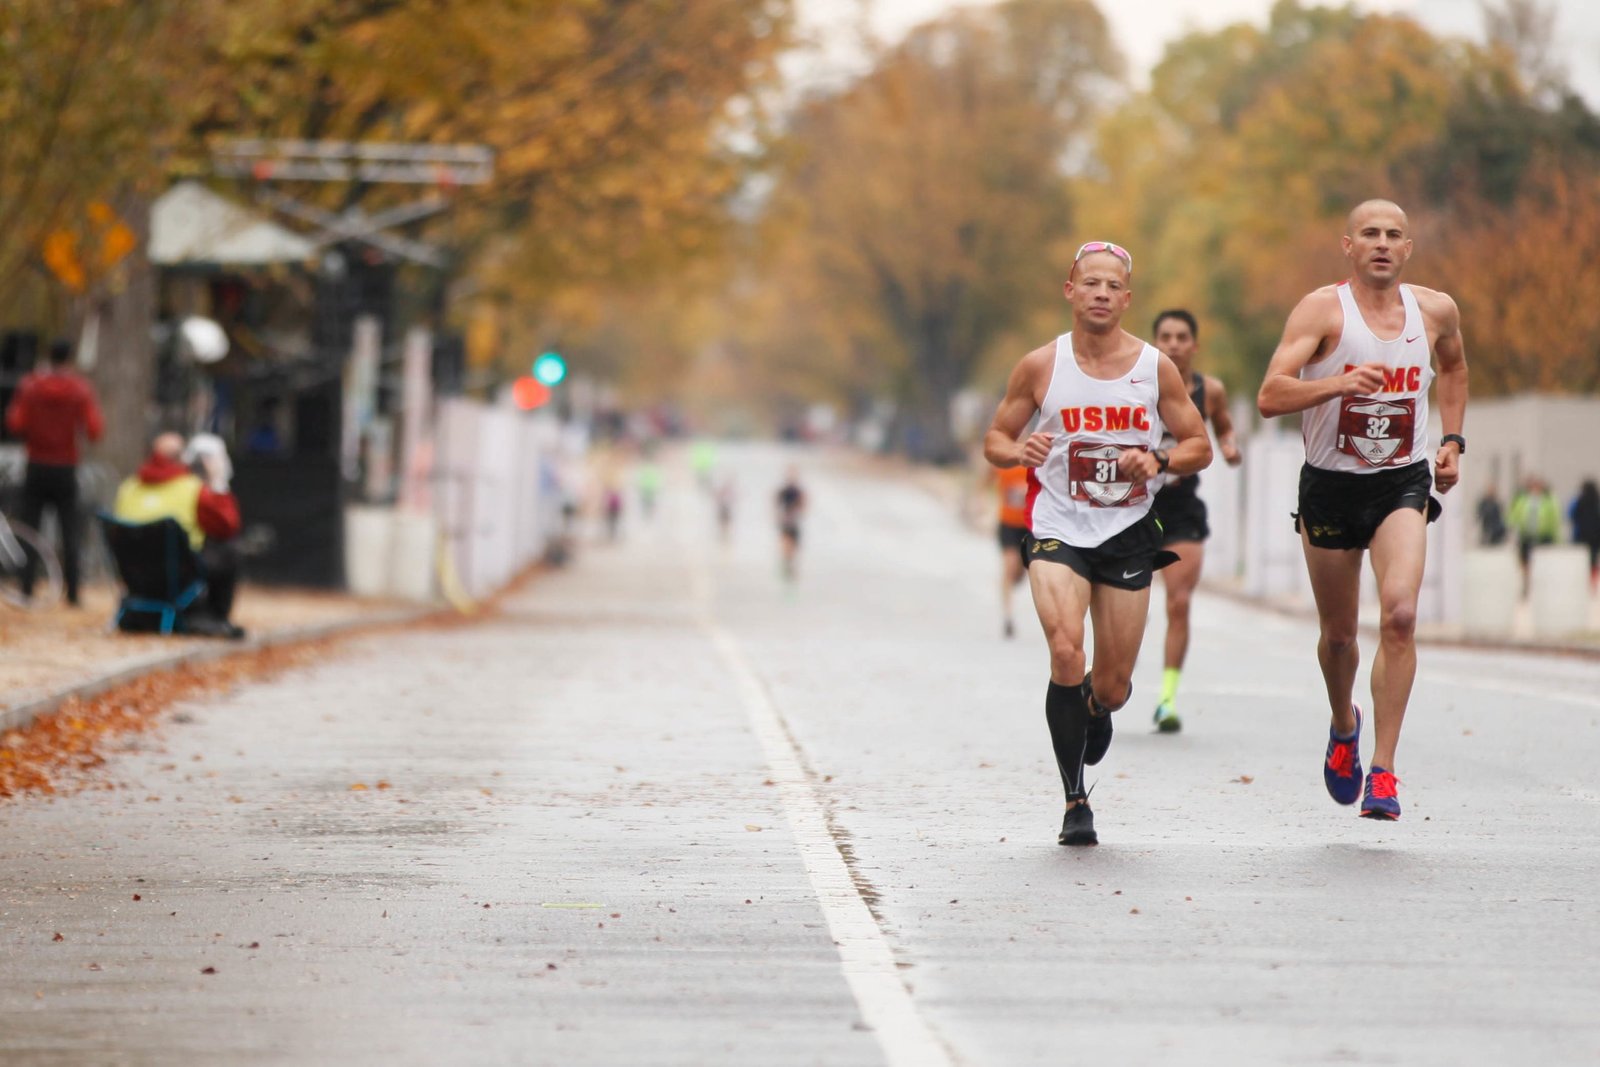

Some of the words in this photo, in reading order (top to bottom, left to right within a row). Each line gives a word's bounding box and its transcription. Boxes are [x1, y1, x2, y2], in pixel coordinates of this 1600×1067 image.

[1060, 406, 1149, 433] USMC
[1366, 417, 1390, 438] 32
[1096, 460, 1117, 482] 31
